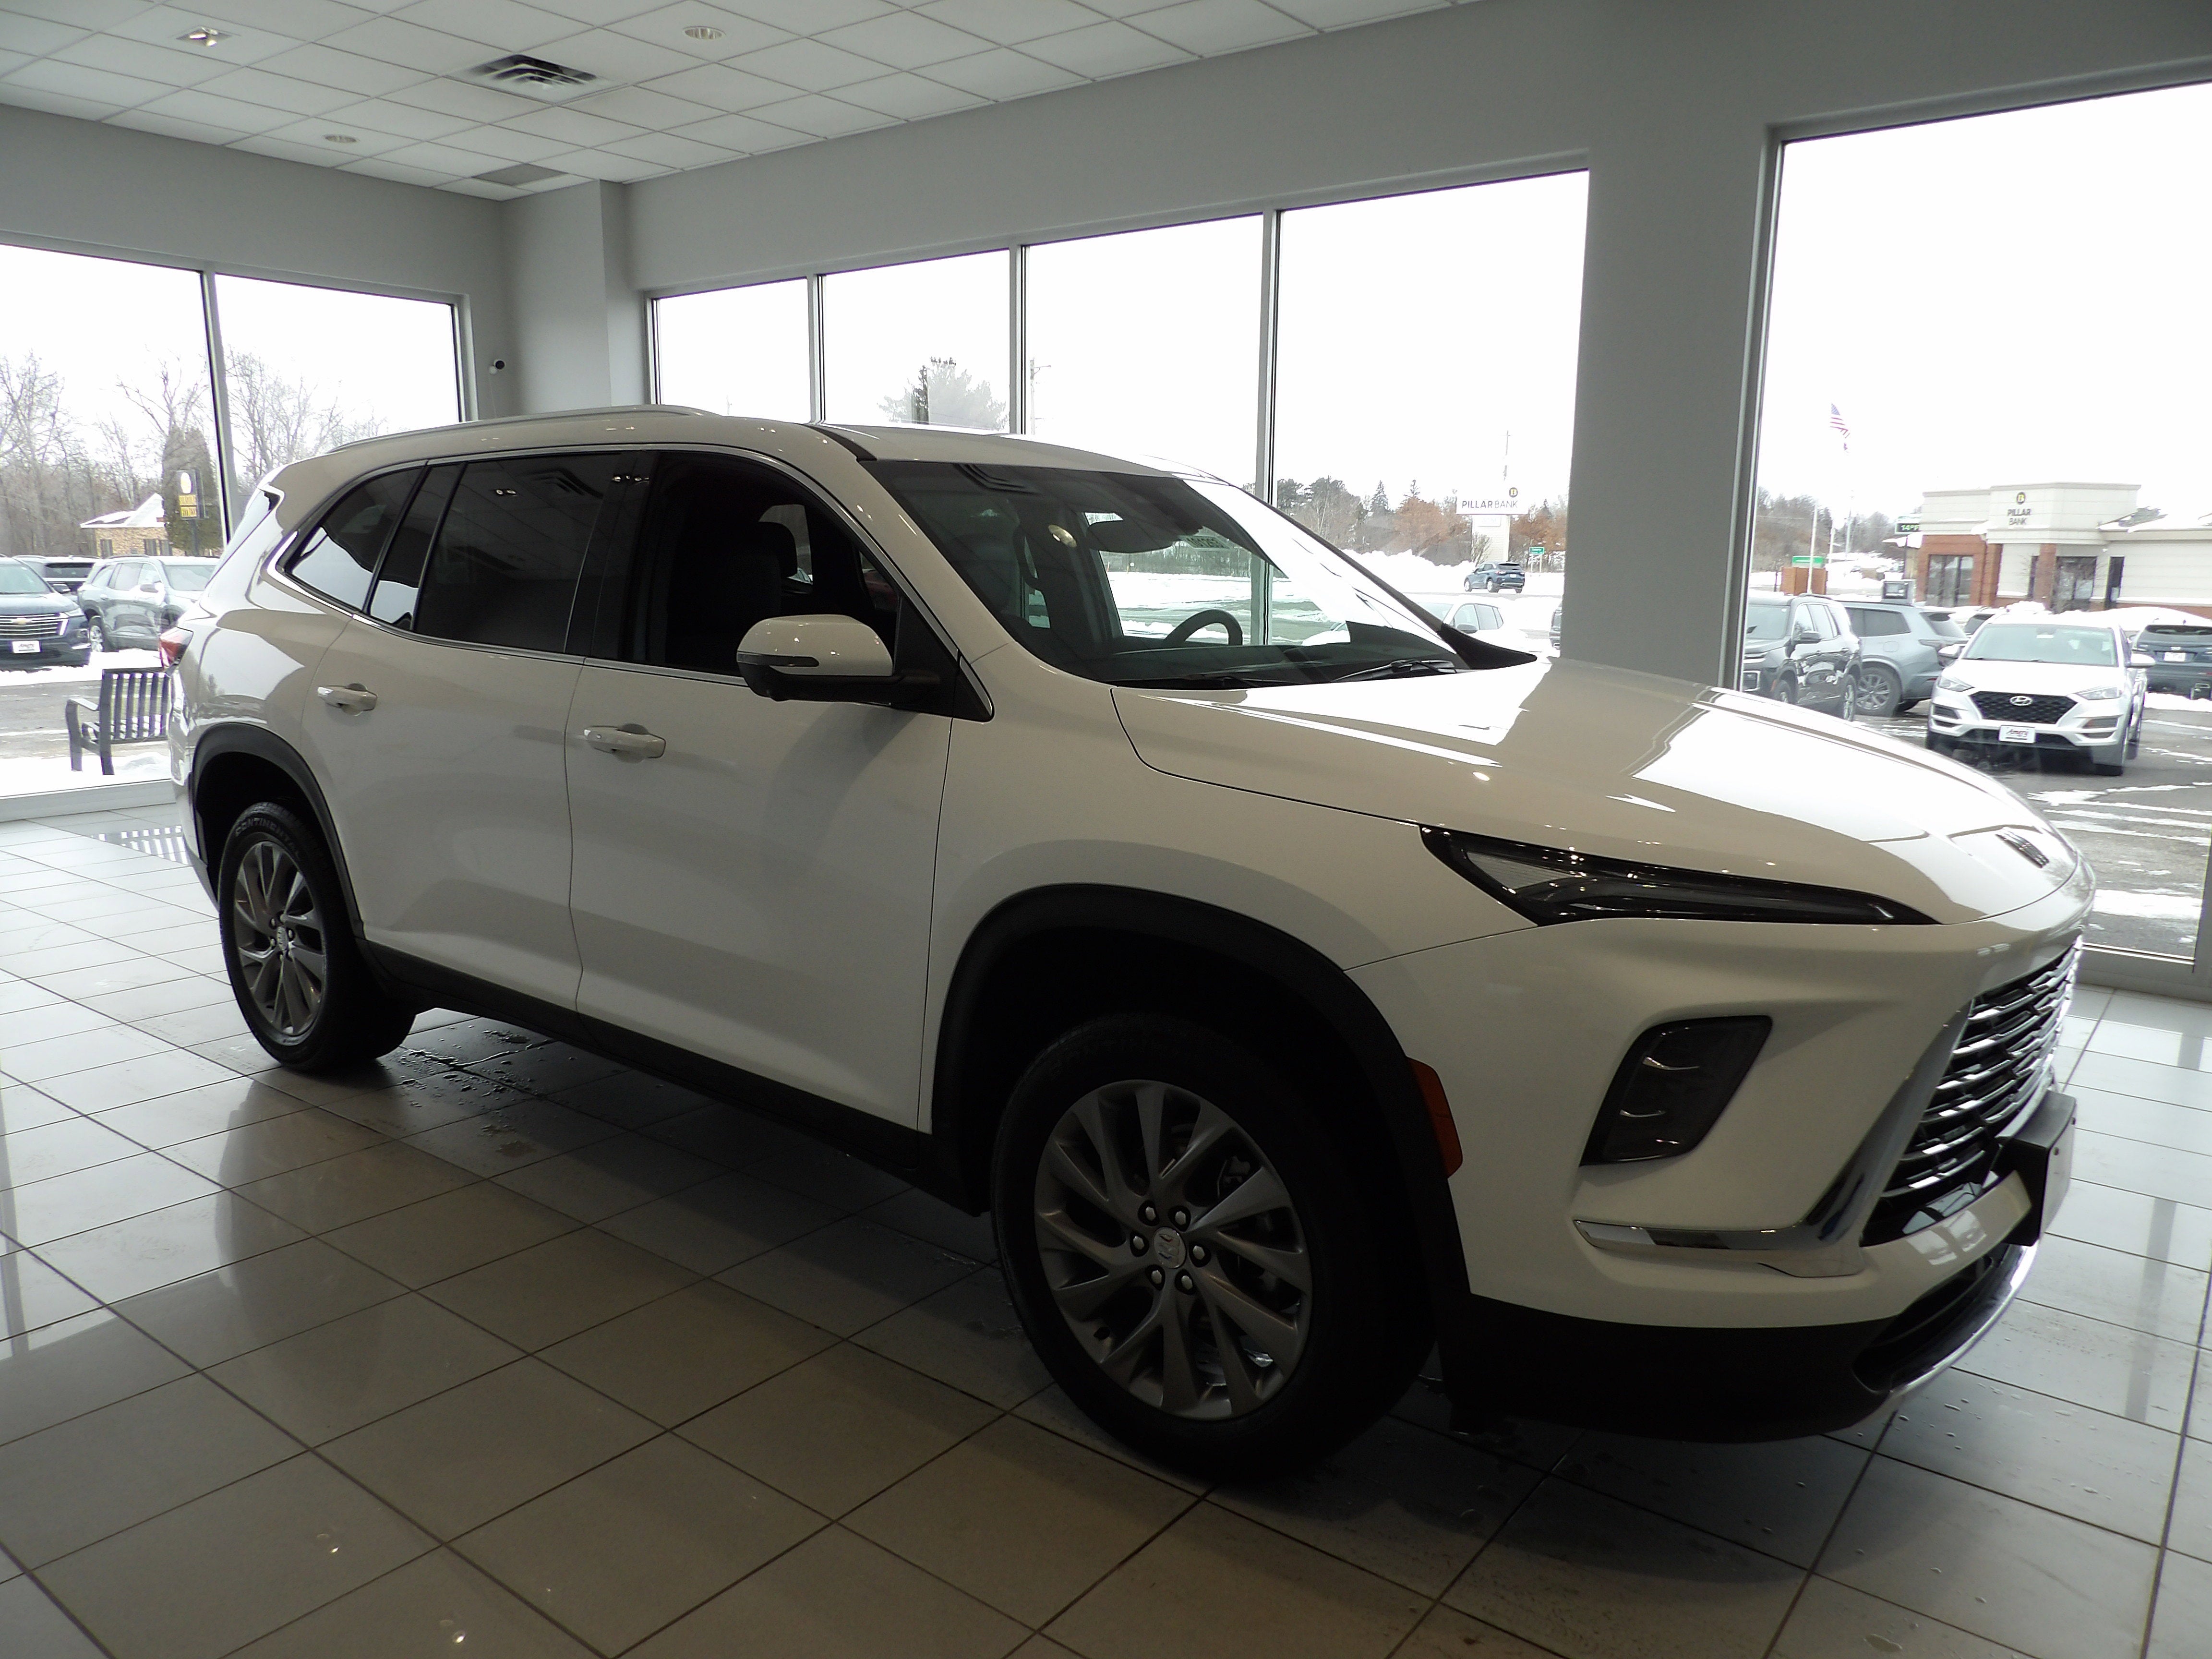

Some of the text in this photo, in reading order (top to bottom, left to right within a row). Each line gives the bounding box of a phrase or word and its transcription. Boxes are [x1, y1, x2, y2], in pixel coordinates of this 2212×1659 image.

[1462, 500, 1518, 508] PILLAR BANK
[2008, 517, 2028, 526] BANK
